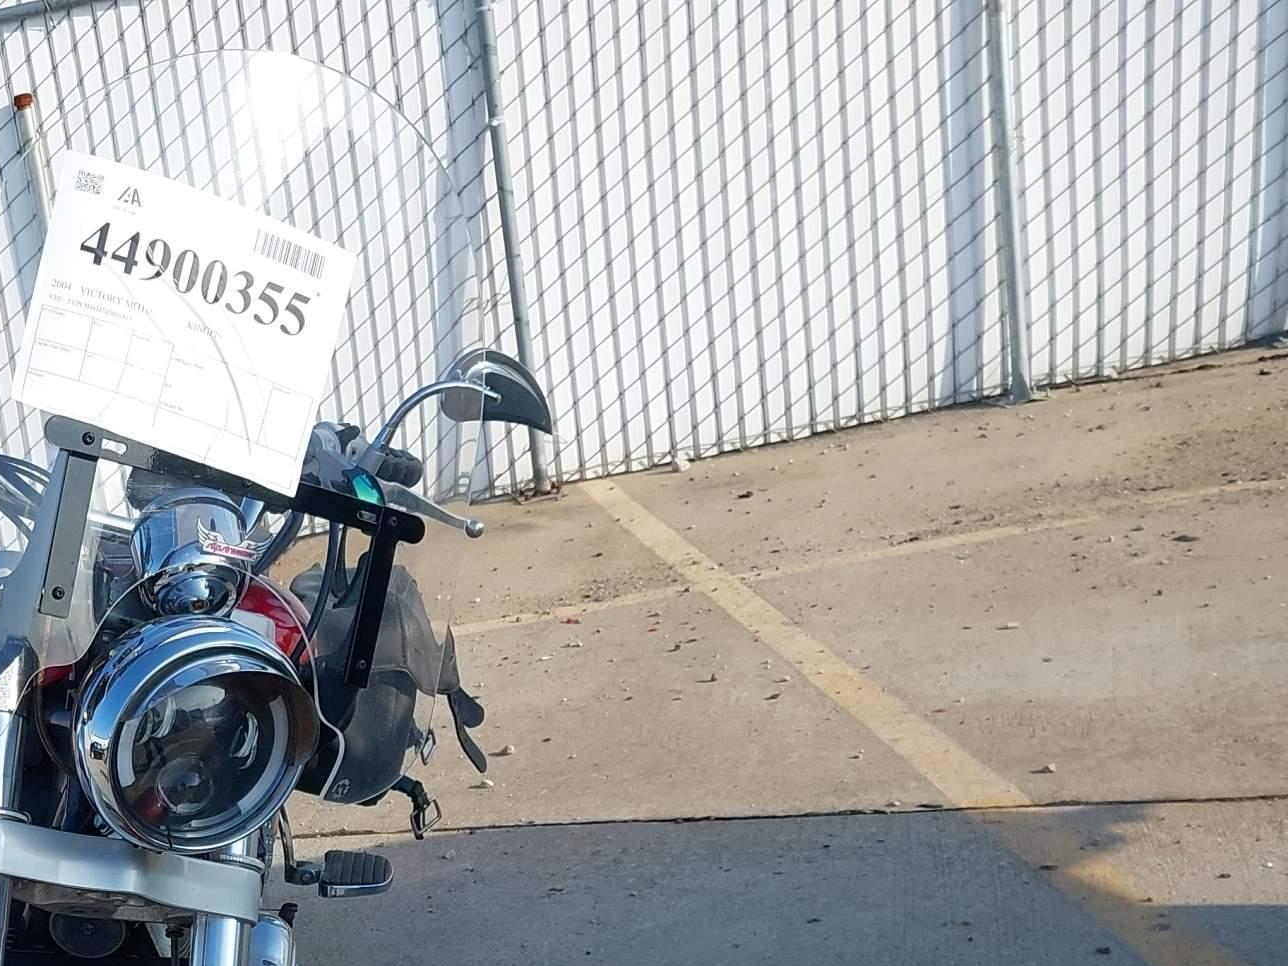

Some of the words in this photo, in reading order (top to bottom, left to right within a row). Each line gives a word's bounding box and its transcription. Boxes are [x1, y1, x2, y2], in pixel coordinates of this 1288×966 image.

[50, 278, 74, 292] 2004
[80, 285, 124, 305] VICTORY
[79, 222, 311, 336] 44900355
